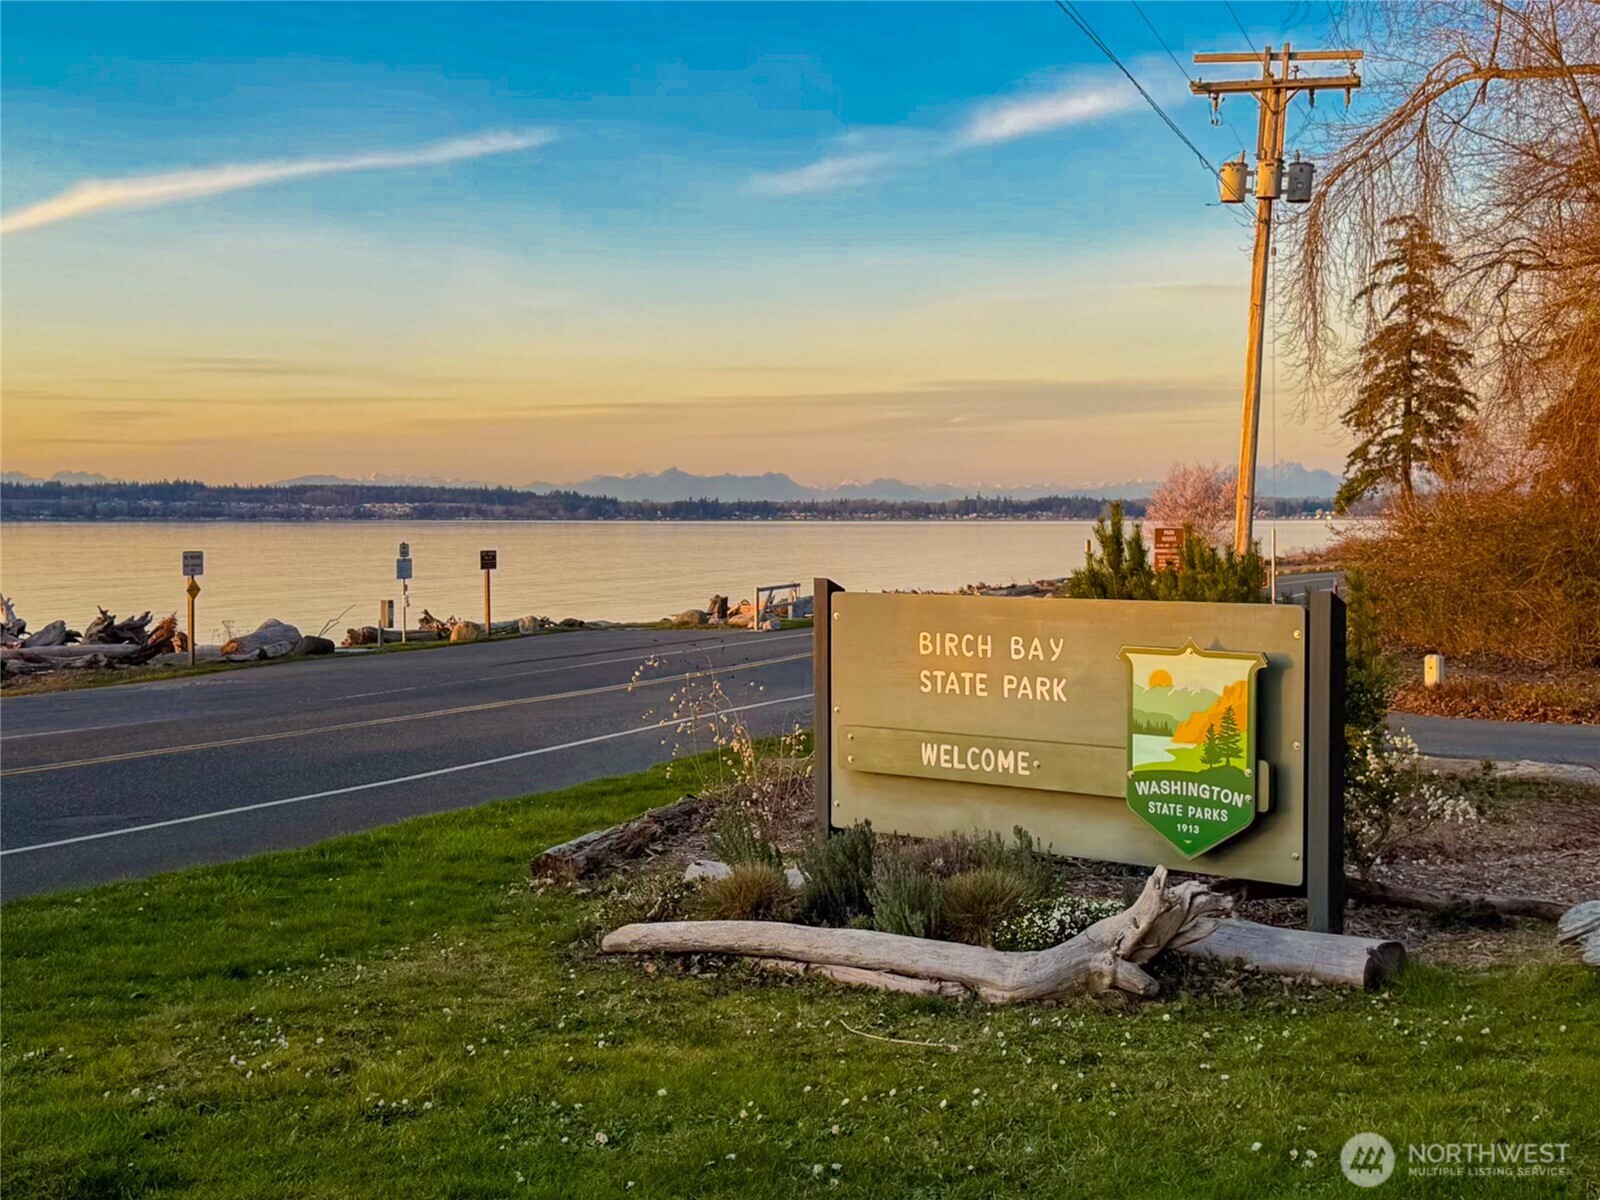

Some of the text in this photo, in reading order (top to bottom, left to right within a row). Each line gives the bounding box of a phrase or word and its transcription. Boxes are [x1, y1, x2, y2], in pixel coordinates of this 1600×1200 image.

[918, 631, 1064, 662] BIRCH BAY
[919, 669, 1068, 703] STATE PARK
[920, 742, 1031, 776] WELCOME
[1135, 779, 1245, 808] WASHINGTON
[1148, 801, 1229, 822] STATE PARKS
[1176, 823, 1200, 834] 1913
